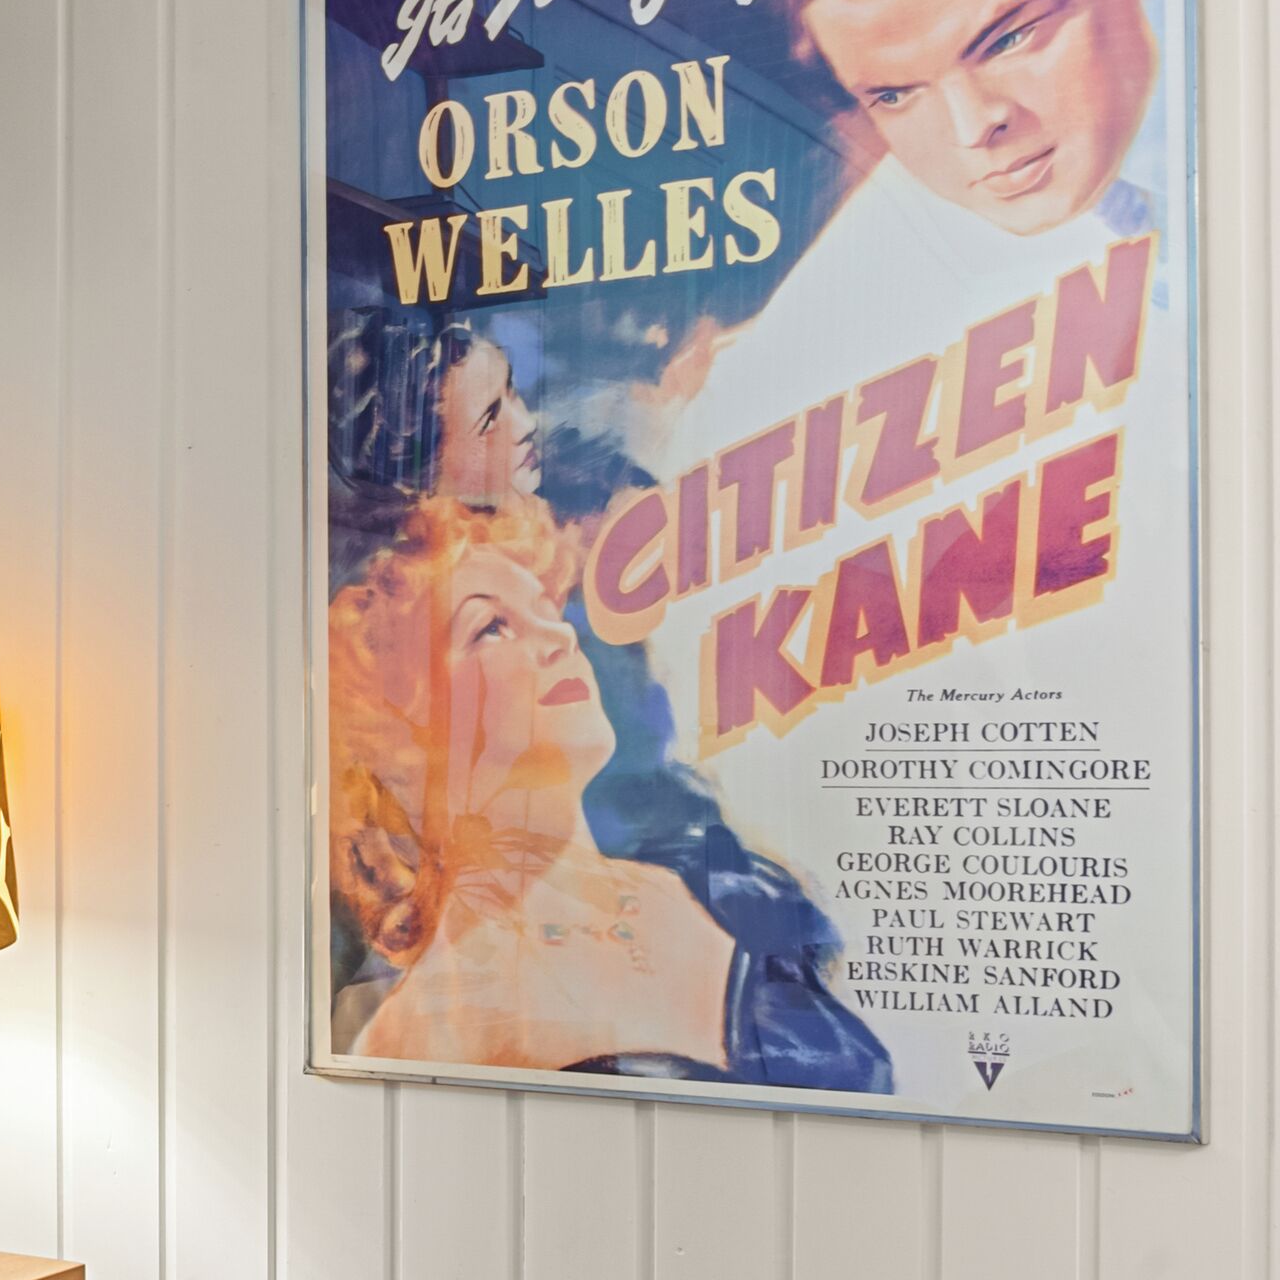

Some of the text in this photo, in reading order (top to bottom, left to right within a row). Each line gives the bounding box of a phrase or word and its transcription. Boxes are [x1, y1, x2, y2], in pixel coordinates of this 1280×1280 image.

[418, 55, 731, 189] ORSON
[383, 168, 781, 305] WELLES
[588, 233, 1156, 628] CITIZEN
[708, 428, 1122, 750] KANE
[906, 688, 1062, 703] The Mercury Actors
[865, 721, 1100, 743] JOSEPH COTTEN
[821, 760, 1150, 781] DOROTHY COMINGORE
[856, 797, 1111, 819] EVERETT SLOANE
[887, 825, 1075, 847] RAY COLLINS
[837, 852, 1128, 878] GEORGE COULOURIS
[835, 881, 1132, 904] AGNES MOOREHEAD
[872, 909, 1095, 933] PAUL STEWART
[867, 936, 1098, 961] RUTH WARRICK
[847, 962, 1120, 989] ERSKINE SANFORD
[854, 990, 1113, 1018] WILLIAM ALLAND
